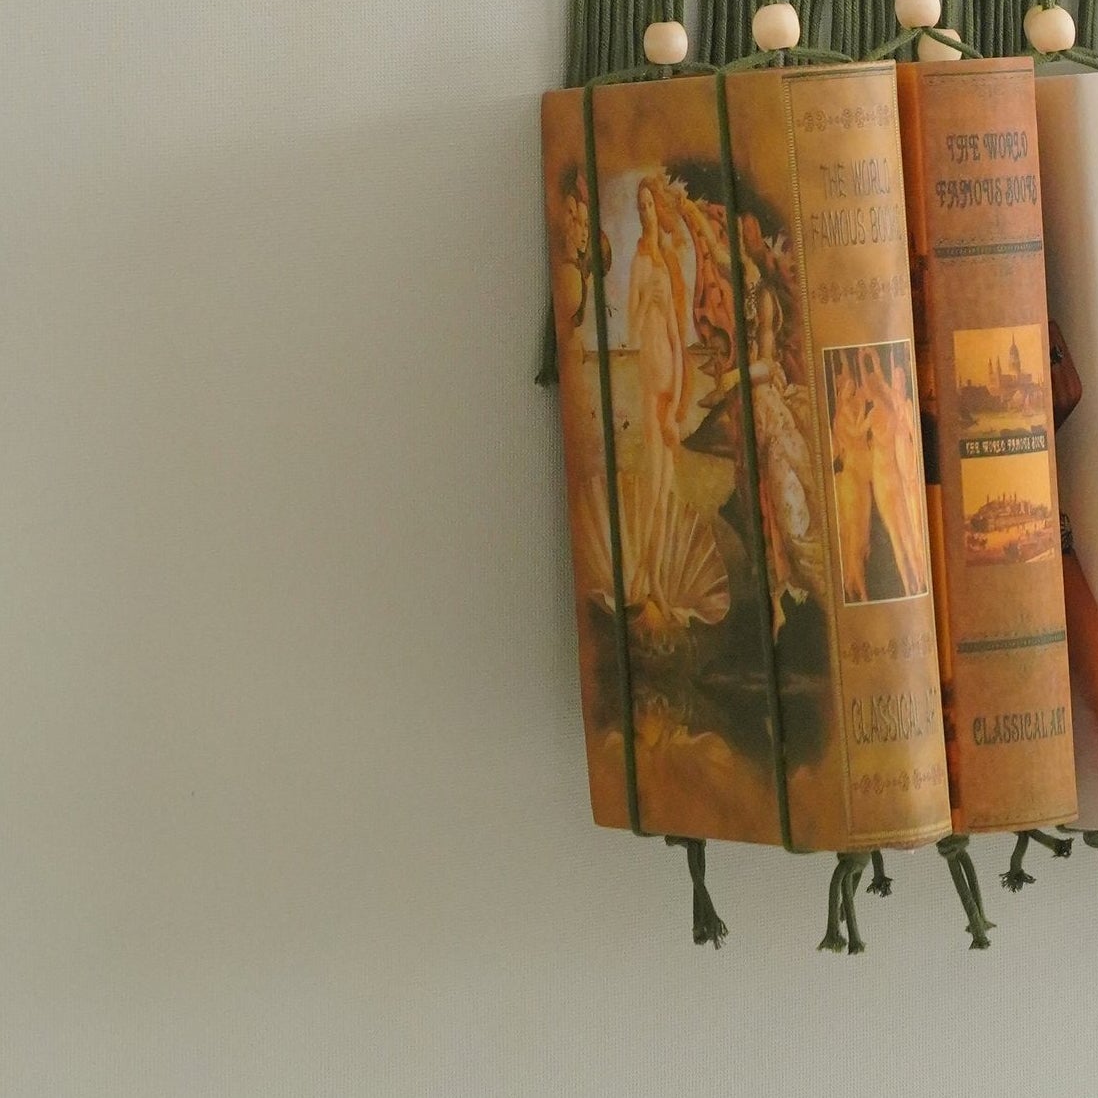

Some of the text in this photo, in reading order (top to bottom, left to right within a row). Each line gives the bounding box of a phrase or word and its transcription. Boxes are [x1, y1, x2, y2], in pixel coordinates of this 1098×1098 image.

[820, 157, 891, 199] THE WORLD
[811, 206, 866, 249] FAMOUS
[851, 693, 923, 744] CLASSICAL
[972, 710, 1048, 746] CLASSICAL
